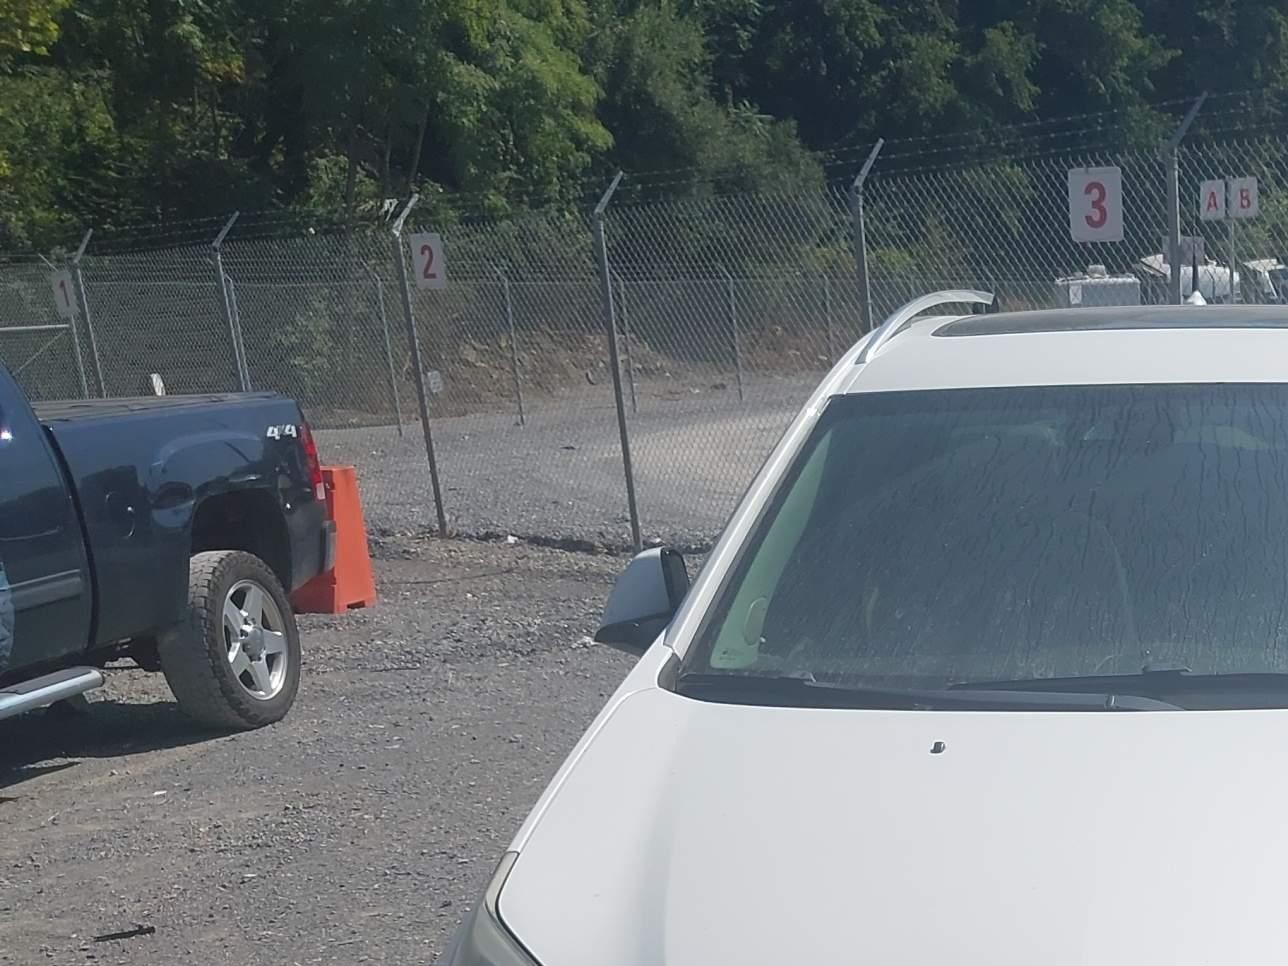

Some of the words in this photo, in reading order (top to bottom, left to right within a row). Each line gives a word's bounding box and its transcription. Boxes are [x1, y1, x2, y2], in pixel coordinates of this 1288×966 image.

[1083, 180, 1108, 230] 3
[1207, 191, 1218, 211] A
[1240, 188, 1251, 209] B
[420, 244, 437, 279] 2
[59, 280, 71, 308] 1
